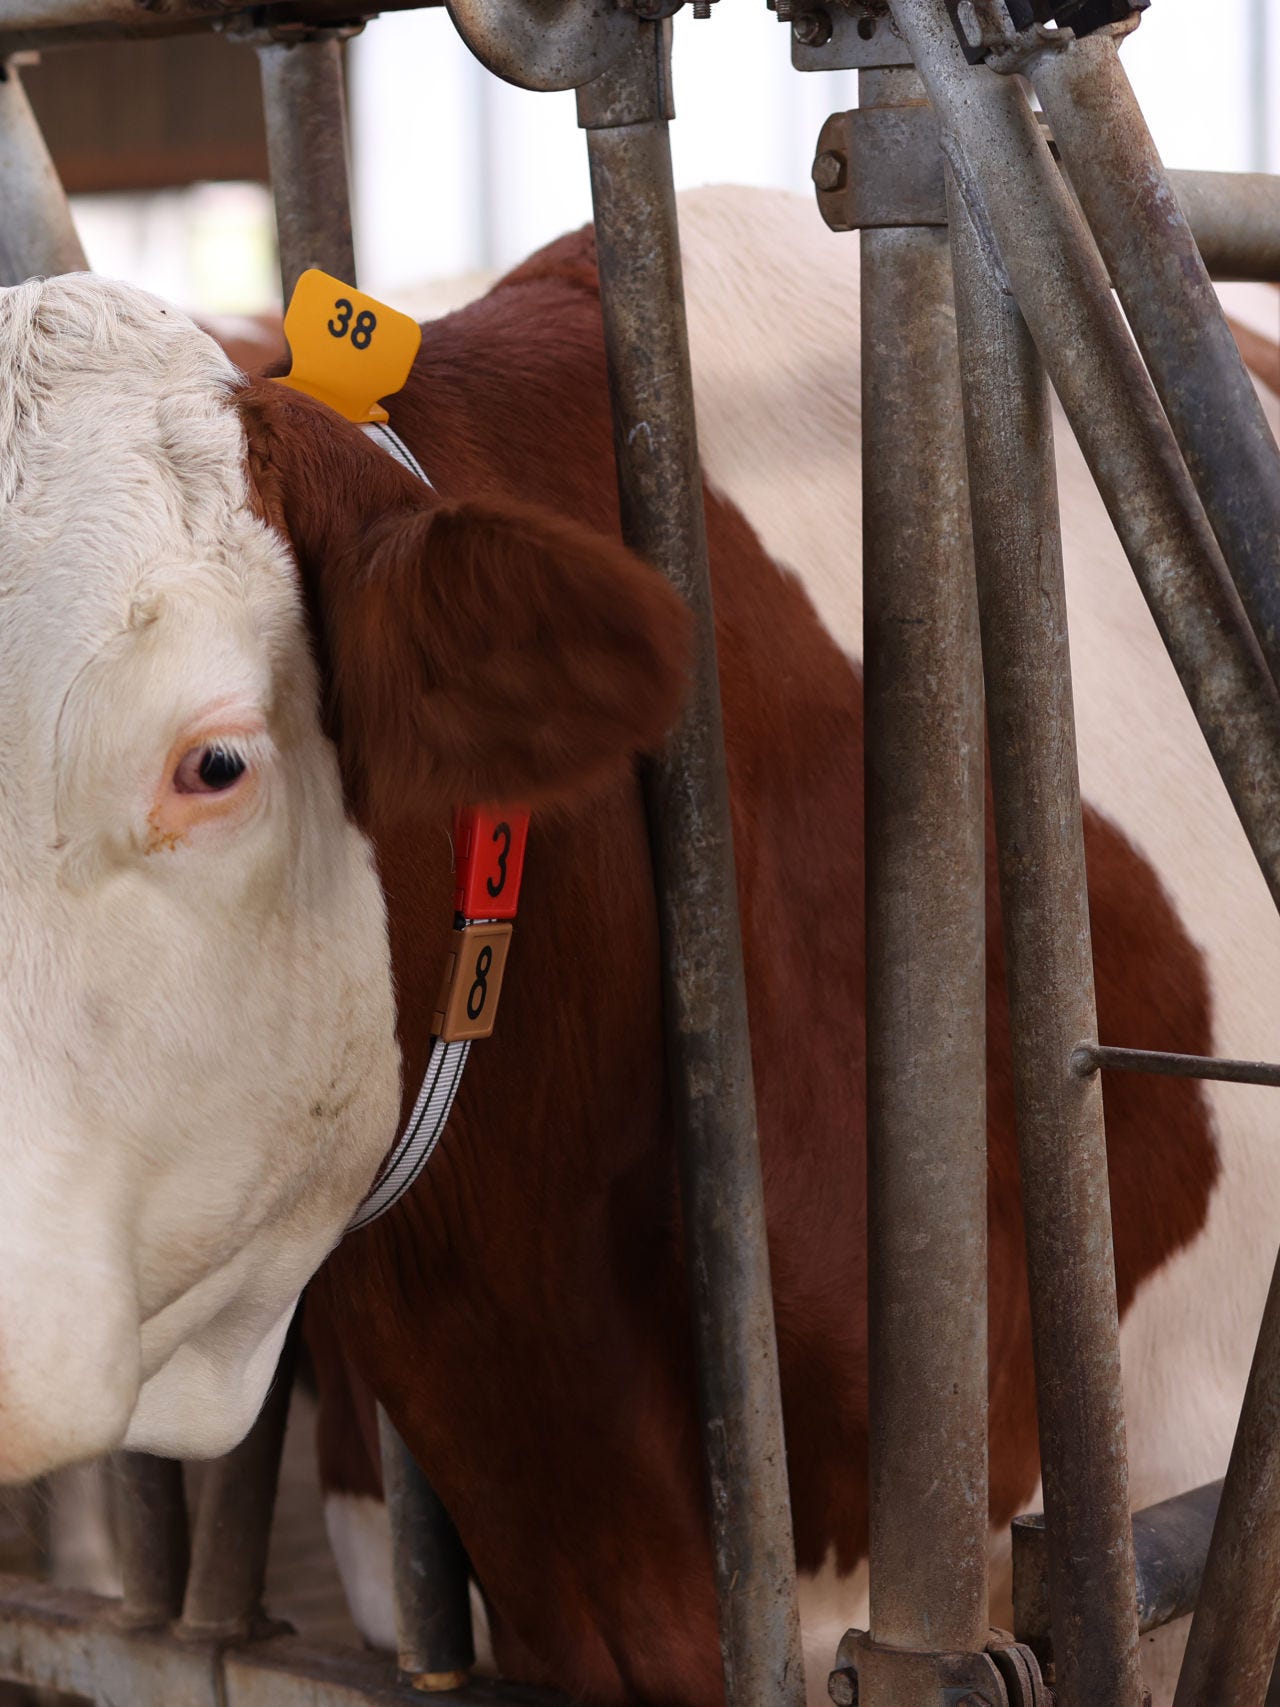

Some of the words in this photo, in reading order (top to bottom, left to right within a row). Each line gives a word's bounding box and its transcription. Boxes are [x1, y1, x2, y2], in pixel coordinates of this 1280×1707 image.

[327, 298, 377, 350] 38
[486, 821, 512, 898] 3
[466, 945, 493, 1020] 8
